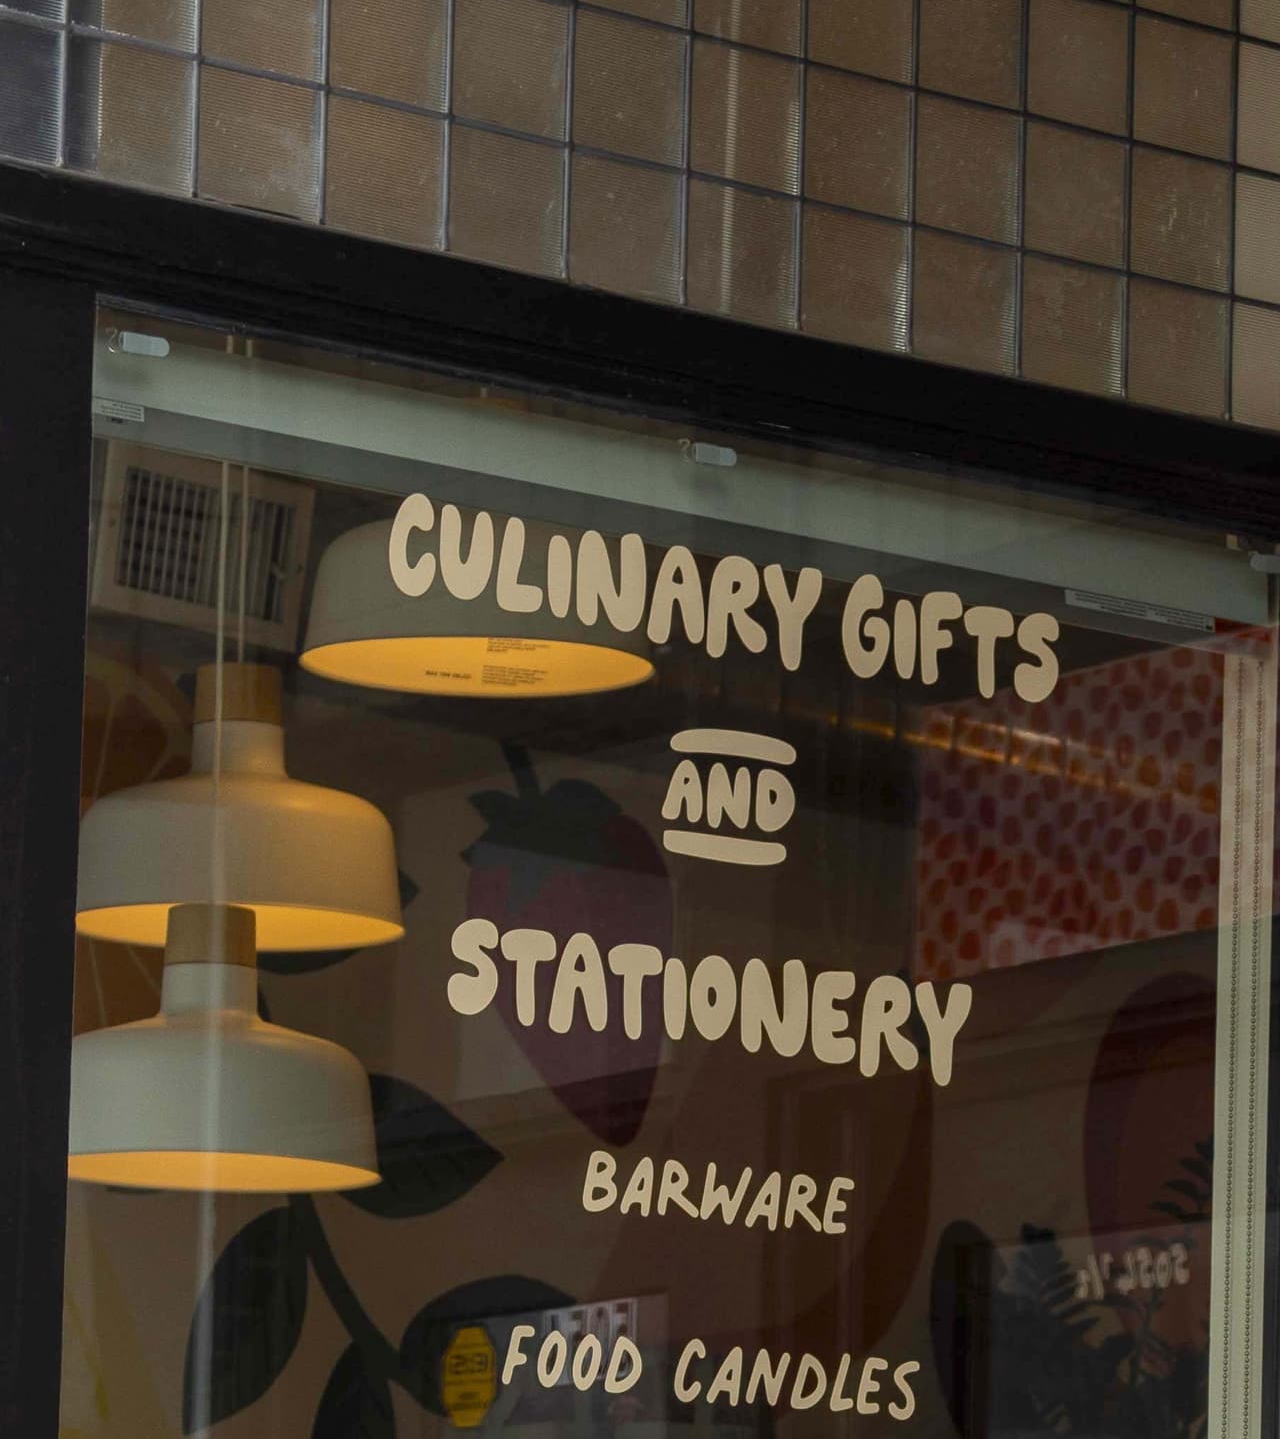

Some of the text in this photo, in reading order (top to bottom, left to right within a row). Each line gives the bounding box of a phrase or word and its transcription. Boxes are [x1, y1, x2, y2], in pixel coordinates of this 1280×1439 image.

[388, 493, 1058, 702] CULINARY GIFTS
[662, 760, 795, 832] AND
[448, 919, 971, 1086] STATIONERY
[583, 1151, 854, 1233] BARWARE
[502, 1326, 642, 1393] FOOD
[675, 1339, 919, 1420] CANDLES
